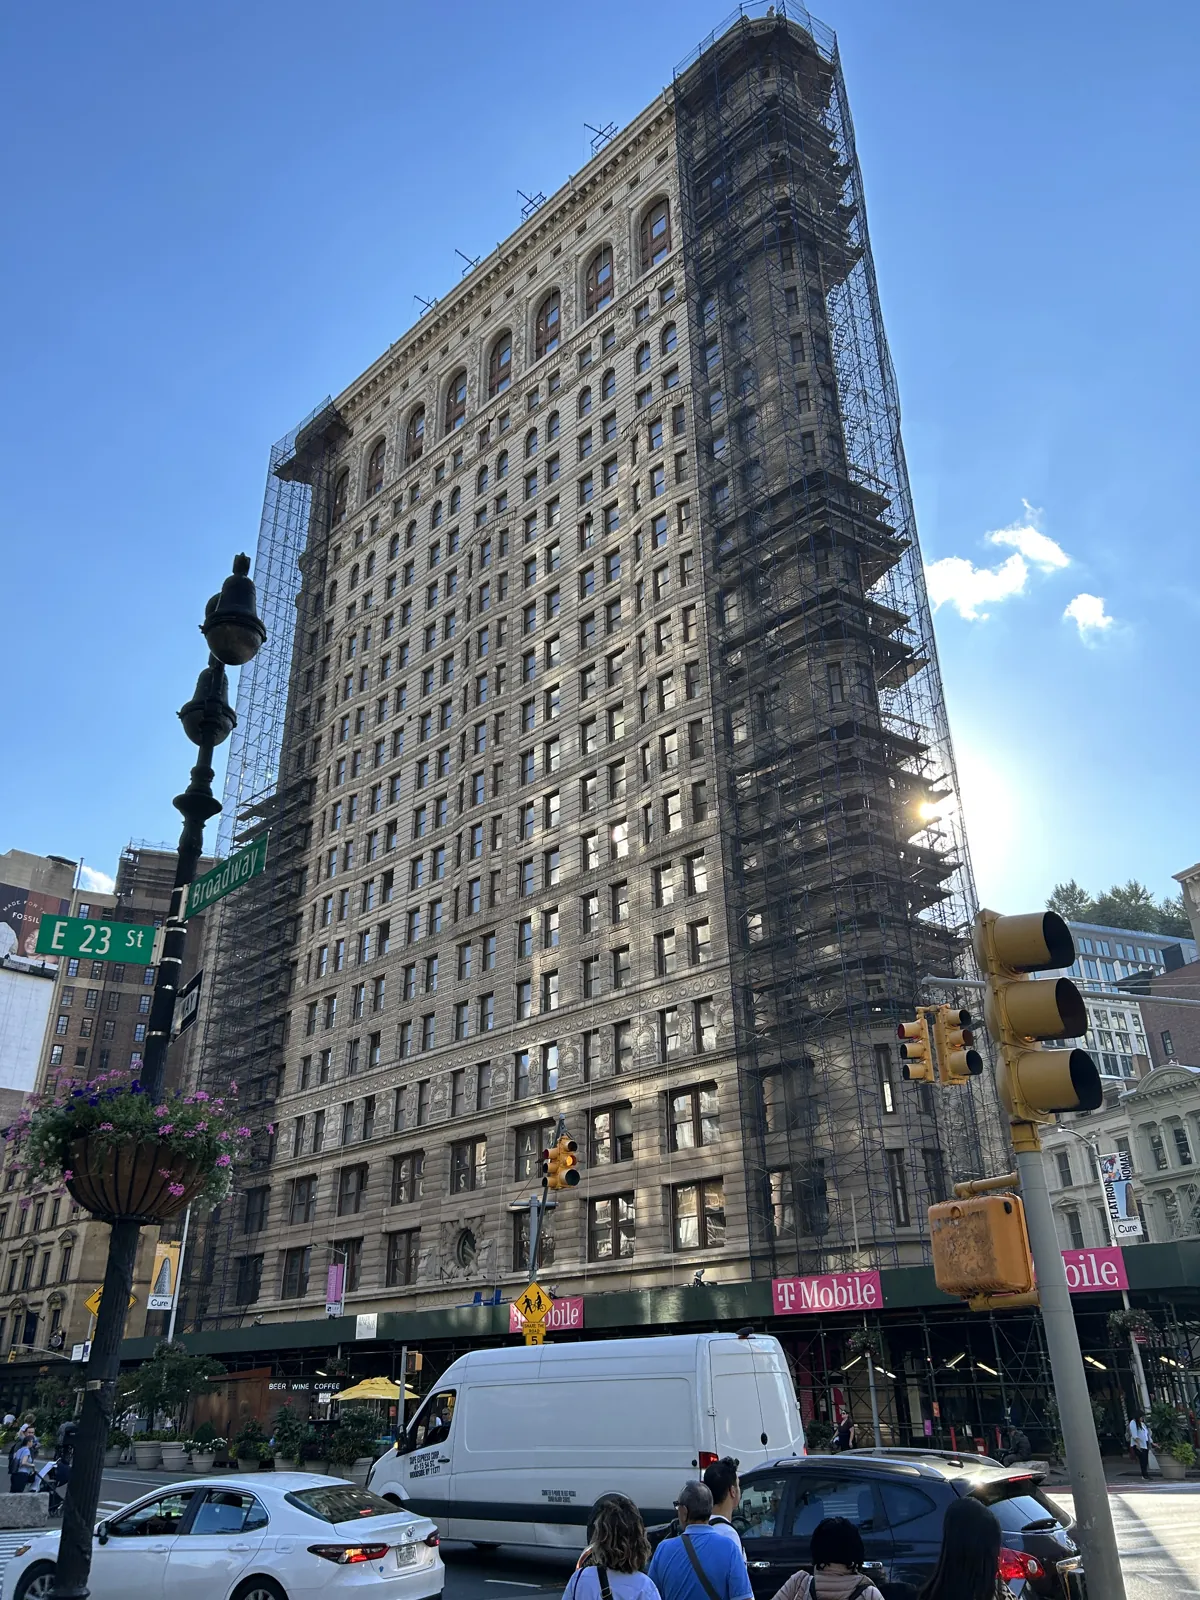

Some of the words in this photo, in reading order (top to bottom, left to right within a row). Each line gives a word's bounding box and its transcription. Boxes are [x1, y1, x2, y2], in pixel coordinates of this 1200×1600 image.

[192, 847, 258, 909] Broadway
[3, 900, 21, 912] MADE
[24, 900, 38, 909] FOR
[12, 911, 39, 923] FOSSIL
[51, 921, 68, 950] E
[78, 924, 112, 955] 23
[125, 929, 144, 948] St
[1119, 1151, 1133, 1180] NOMAD
[1104, 1181, 1120, 1219] FLATIRON
[1118, 1225, 1137, 1233] Cure
[1061, 1254, 1118, 1287] bile
[151, 1299, 169, 1307] Cure
[778, 1283, 795, 1310] T
[799, 1277, 876, 1308] Mobile
[544, 1302, 579, 1327] obile
[314, 1382, 340, 1390] COFFEE
